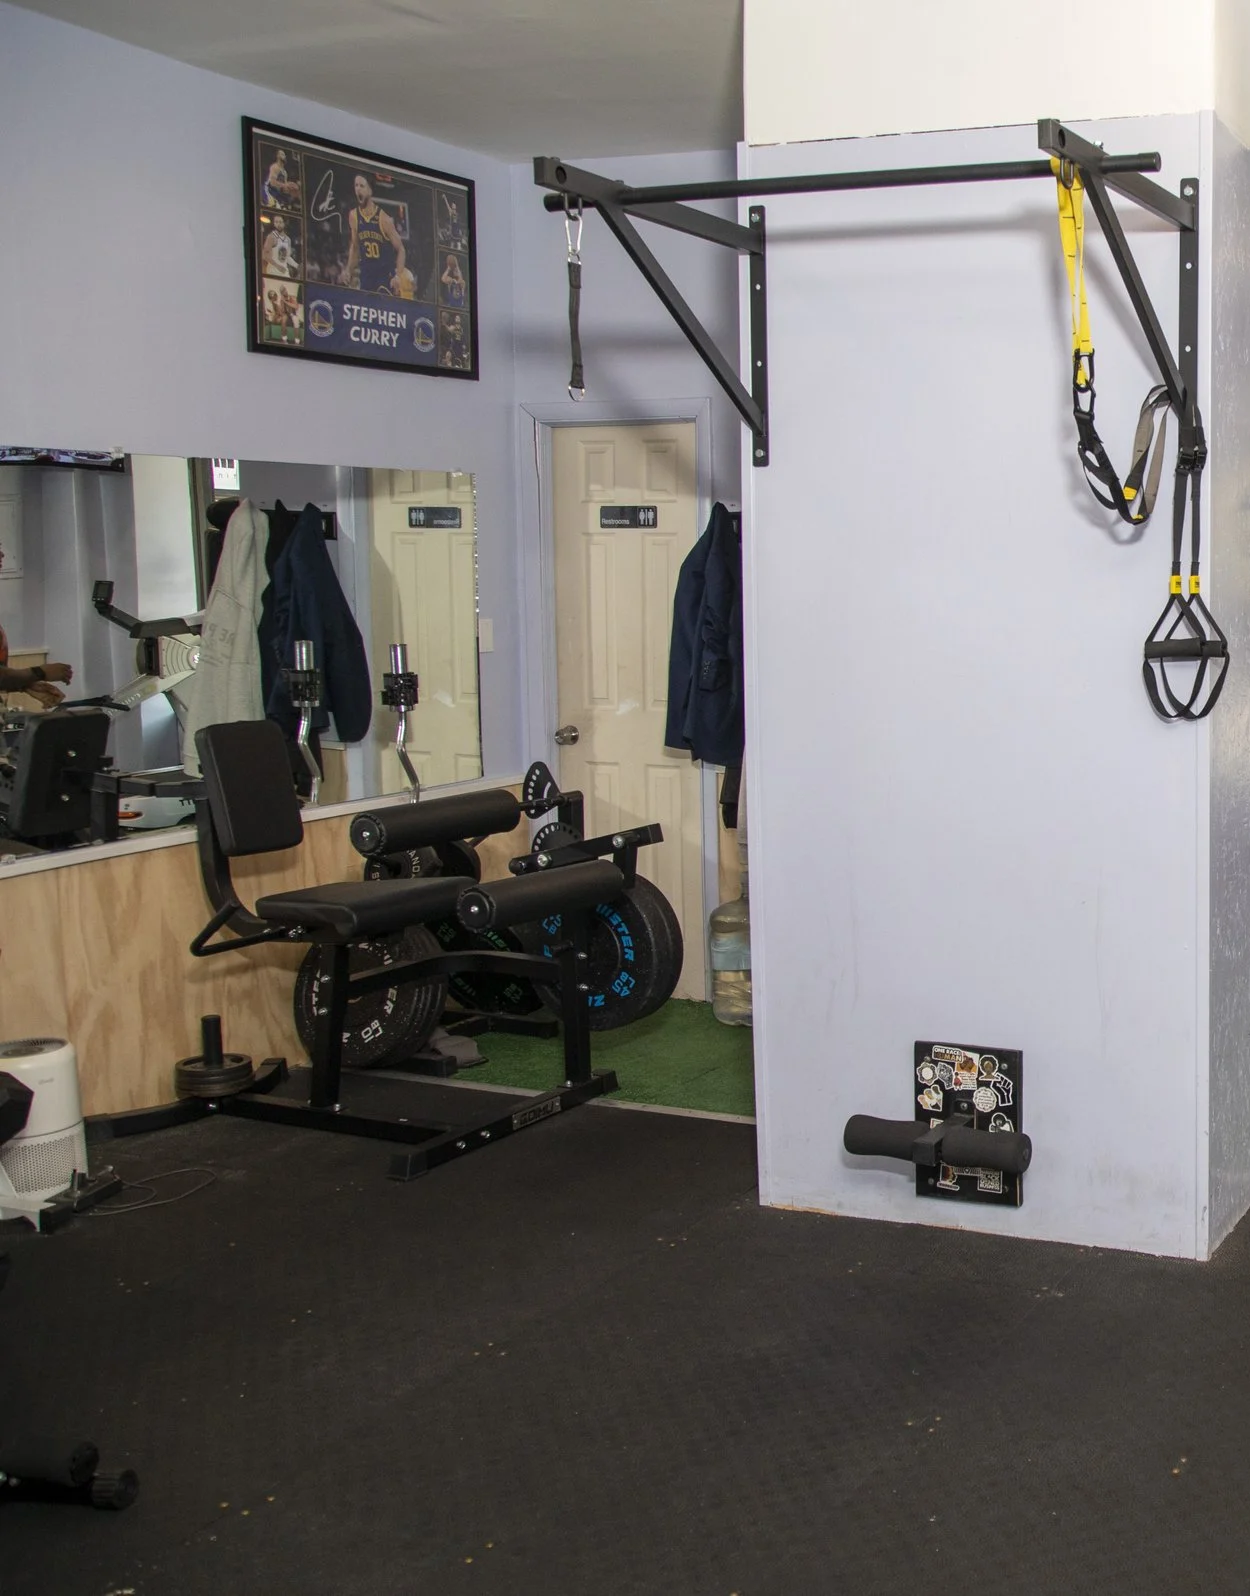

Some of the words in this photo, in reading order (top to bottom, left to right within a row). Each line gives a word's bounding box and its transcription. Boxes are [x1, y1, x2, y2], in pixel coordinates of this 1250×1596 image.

[364, 241, 380, 258] 30
[343, 304, 407, 329] STEPHEN
[350, 326, 399, 348] CURRY
